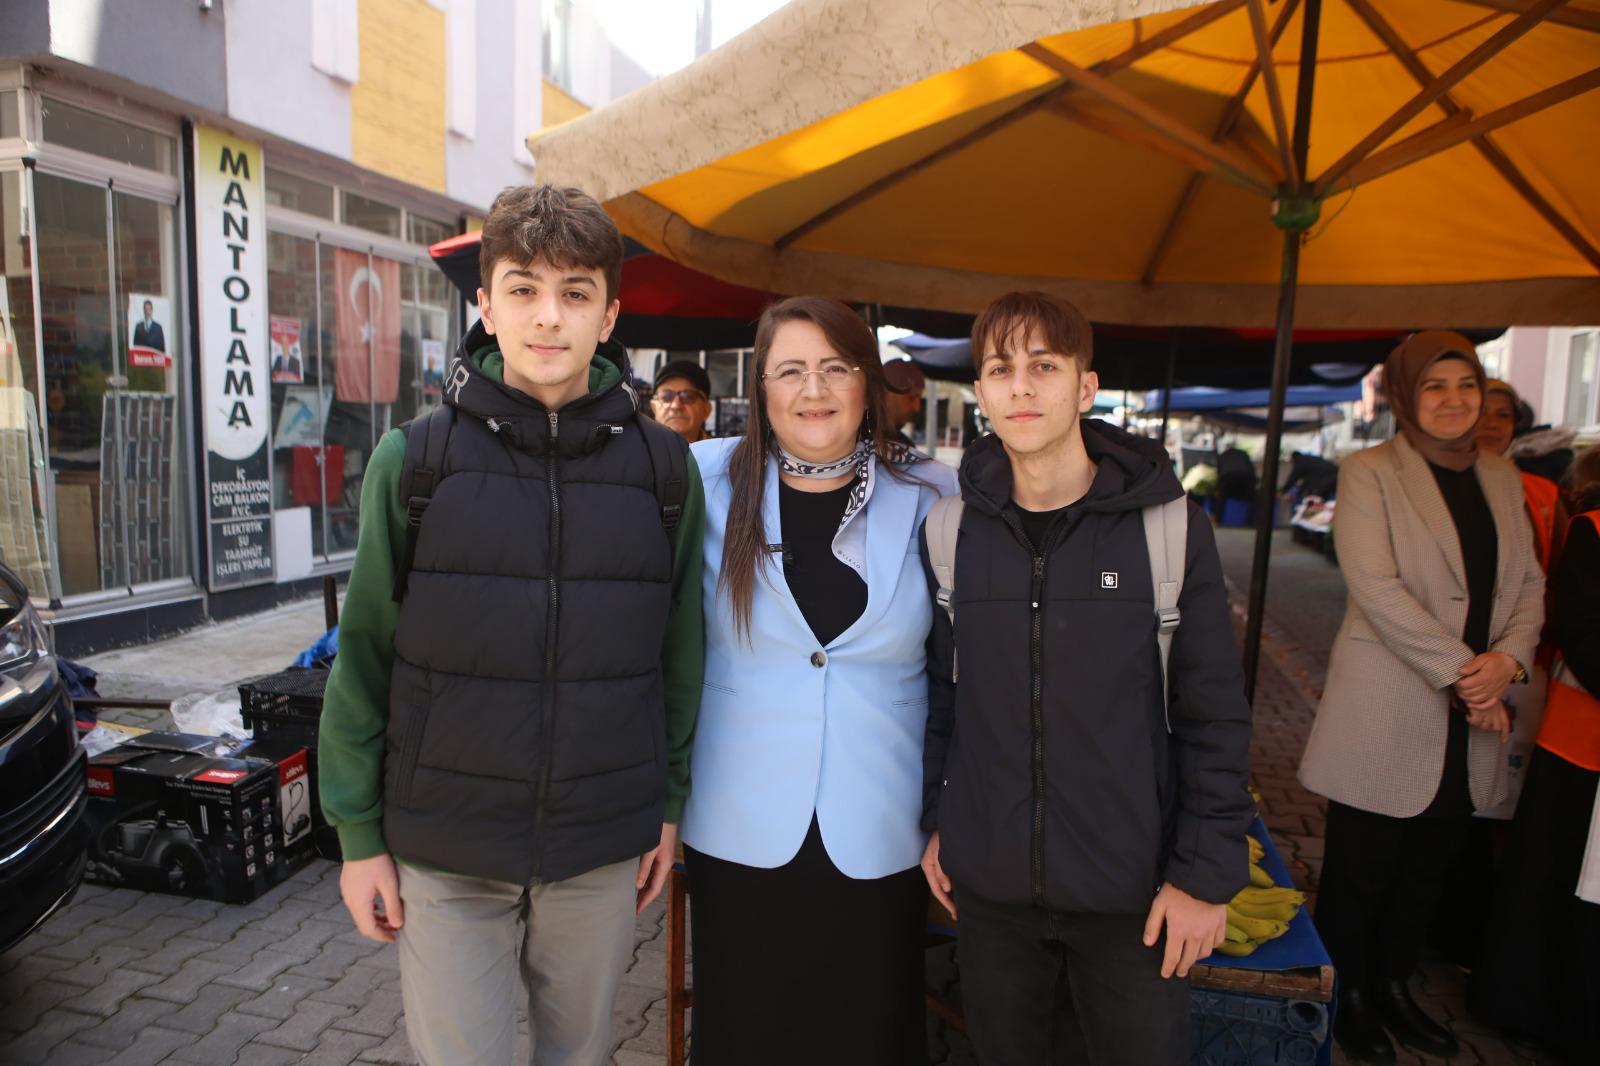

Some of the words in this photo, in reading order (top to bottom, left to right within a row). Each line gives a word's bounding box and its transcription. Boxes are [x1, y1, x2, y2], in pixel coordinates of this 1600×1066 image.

[219, 146, 254, 428] MANTOLAMA
[211, 481, 269, 494] DEKORASYON
[212, 494, 233, 507] CAM
[234, 492, 270, 505] BALKON
[238, 535, 249, 547] SU
